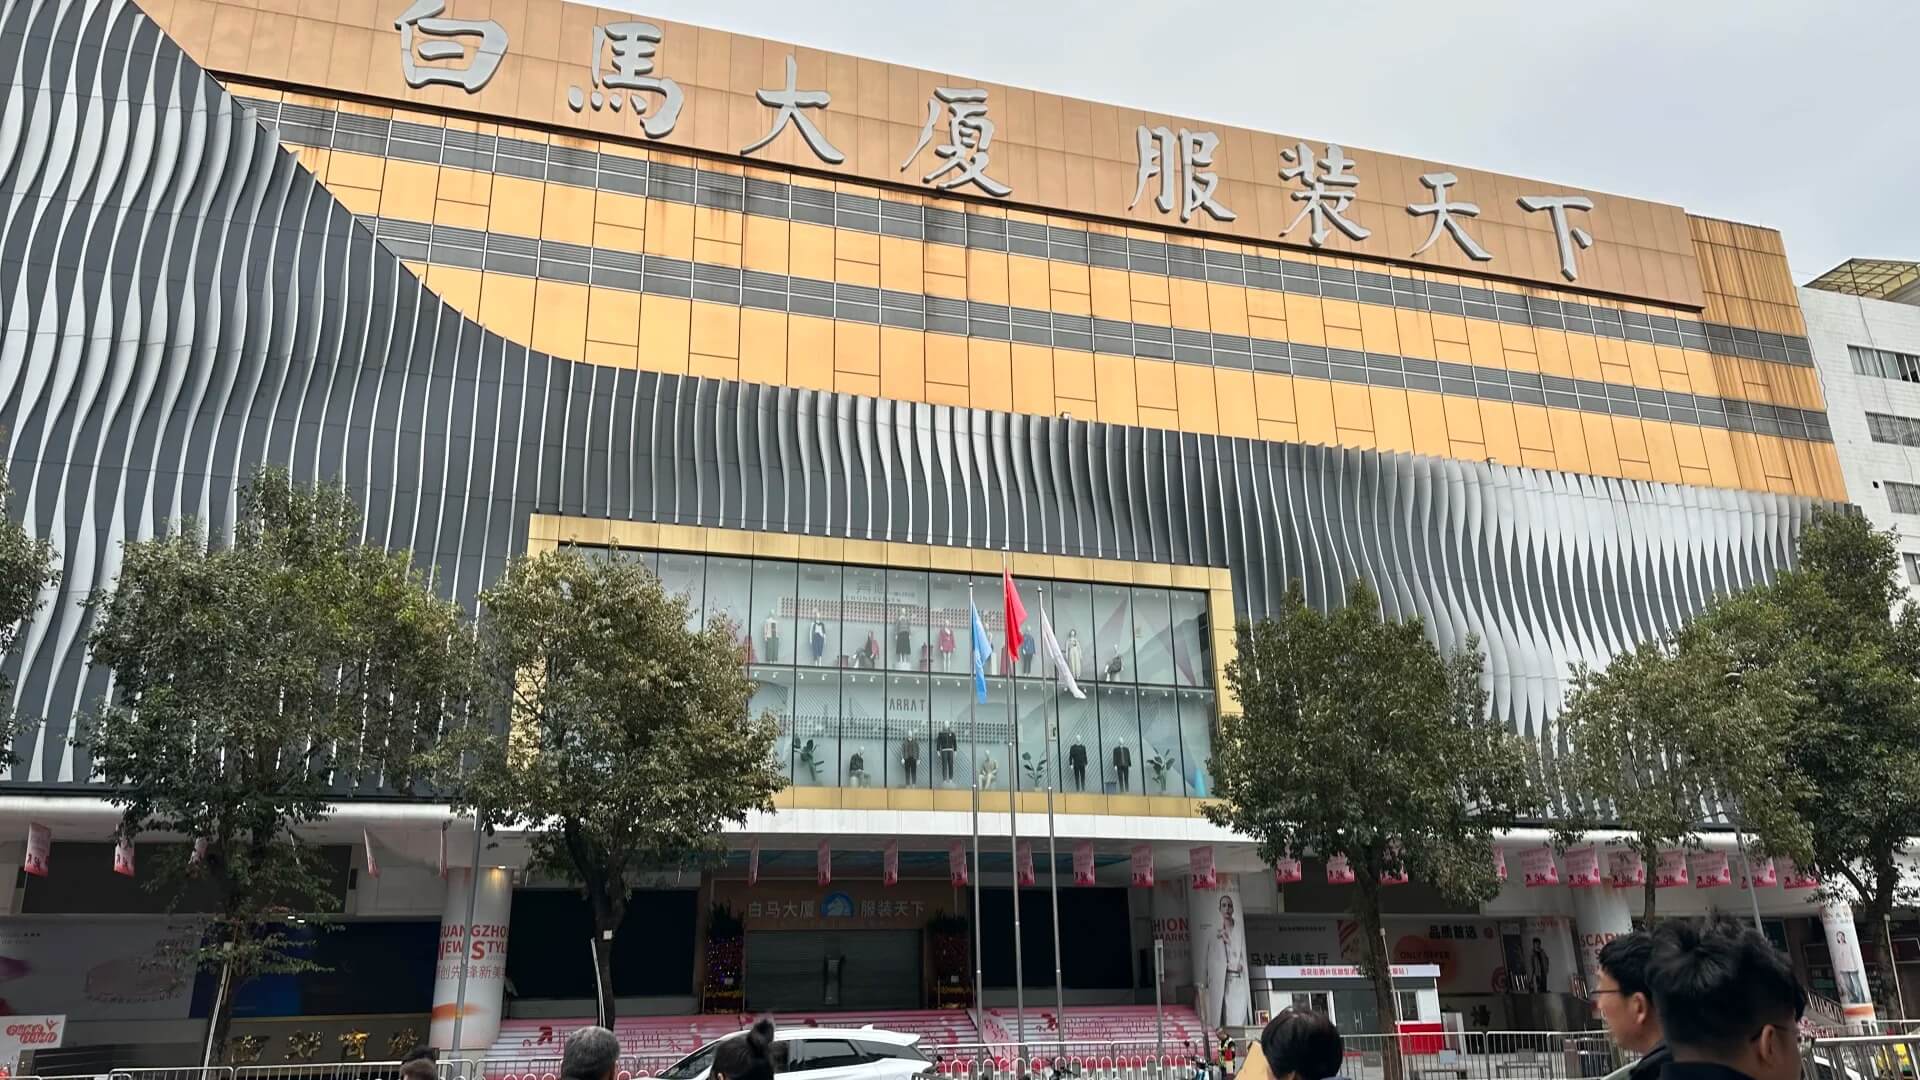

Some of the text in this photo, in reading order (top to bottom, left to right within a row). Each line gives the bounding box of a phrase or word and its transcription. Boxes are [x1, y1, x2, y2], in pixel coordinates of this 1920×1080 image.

[1128, 124, 1595, 282] 服装天下
[748, 900, 926, 920] 白马大厦 服装天下
[1151, 917, 1190, 934] HION
[1429, 924, 1478, 940] 品质首选
[471, 940, 507, 961] STYL
